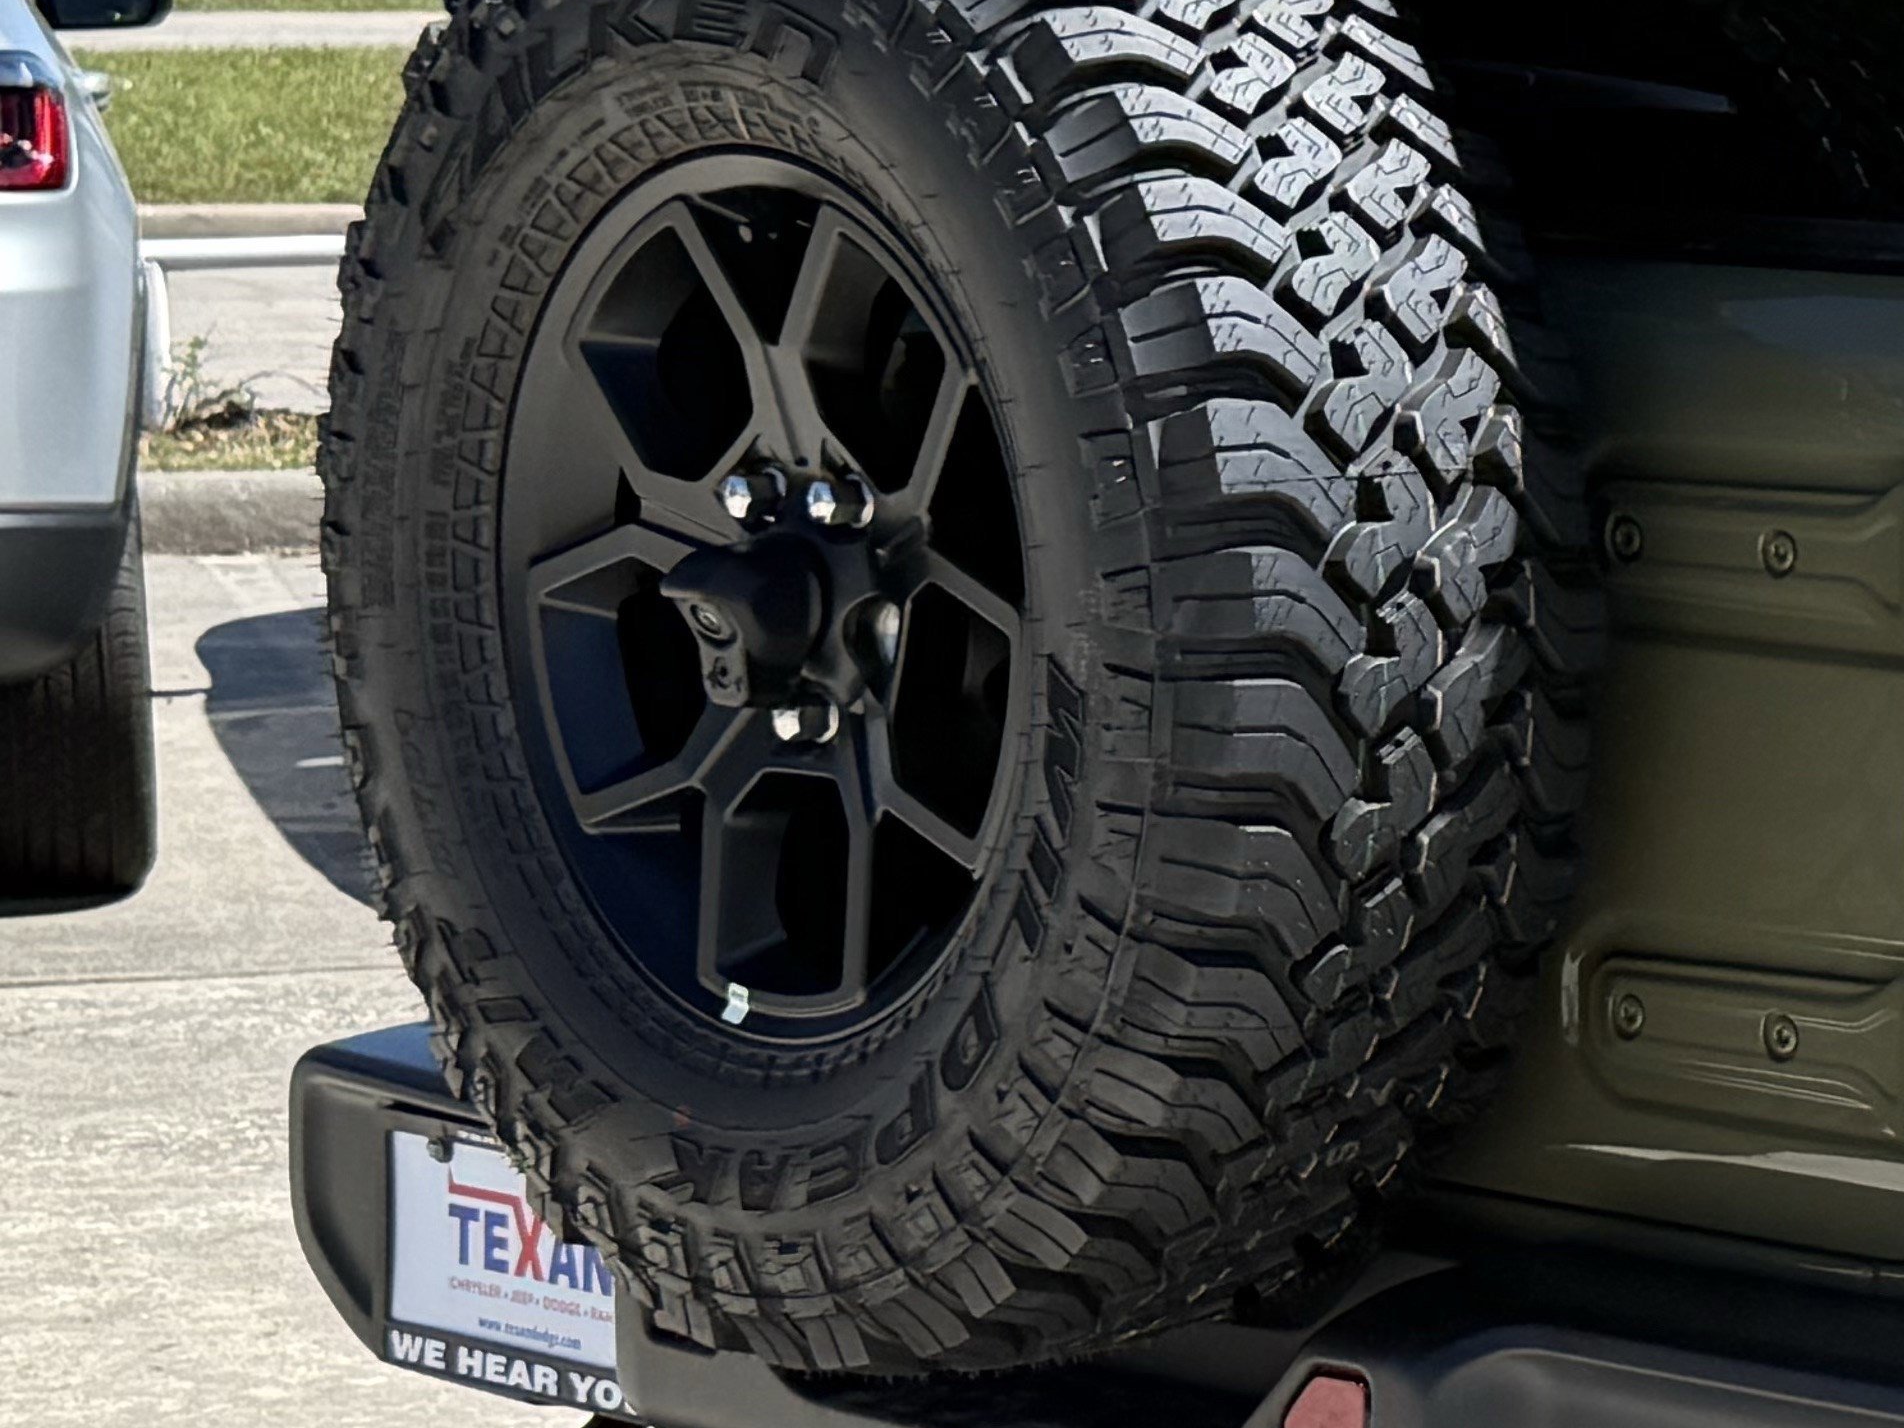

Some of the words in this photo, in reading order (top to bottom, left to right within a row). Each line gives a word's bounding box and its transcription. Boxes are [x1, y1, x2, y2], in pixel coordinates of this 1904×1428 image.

[448, 1200, 615, 1297] TEXAN
[391, 1329, 446, 1371] WE
[457, 1344, 560, 1398] HEAR
[570, 1372, 637, 1417] YO
